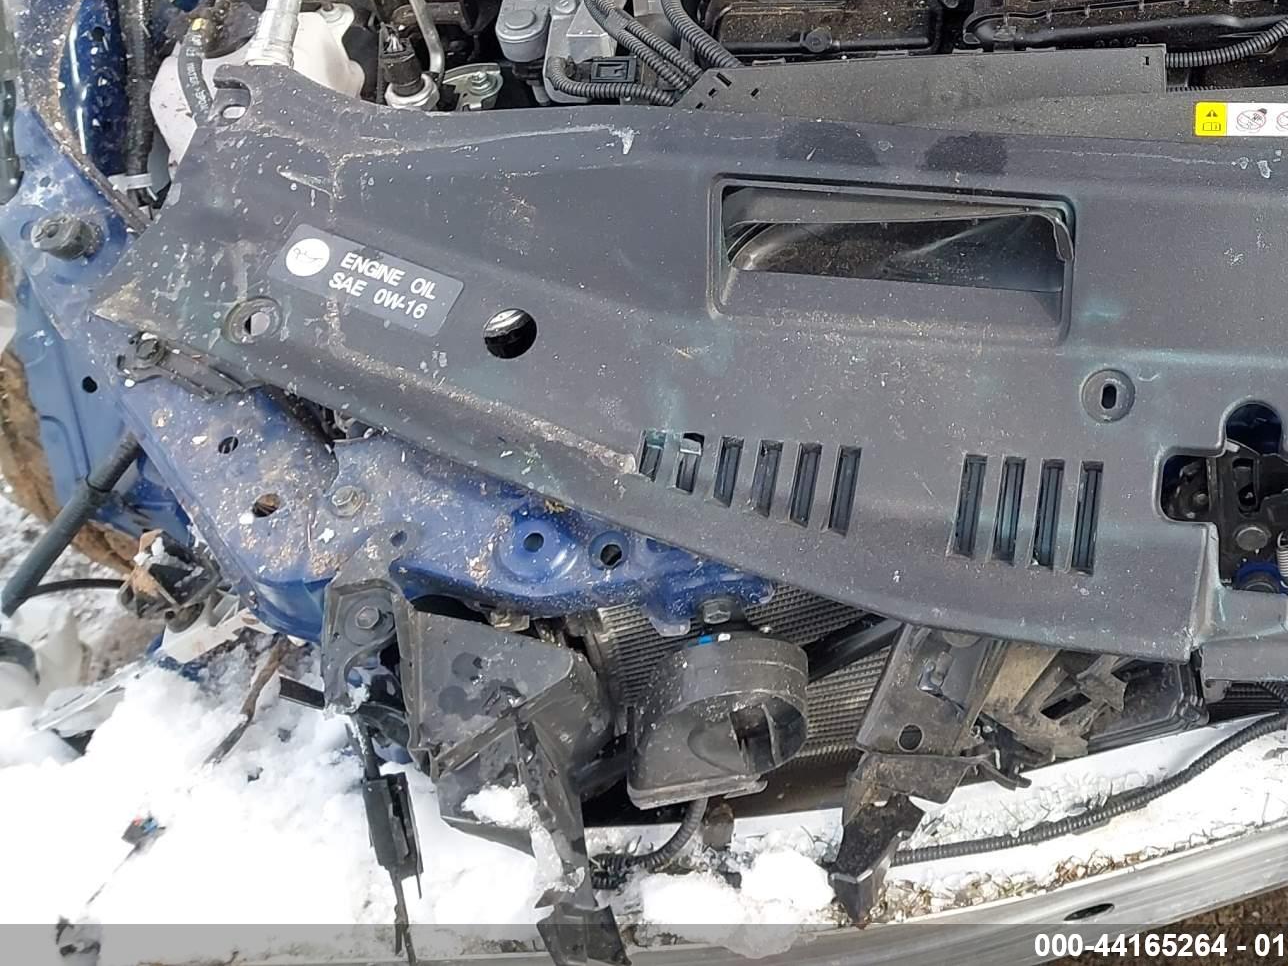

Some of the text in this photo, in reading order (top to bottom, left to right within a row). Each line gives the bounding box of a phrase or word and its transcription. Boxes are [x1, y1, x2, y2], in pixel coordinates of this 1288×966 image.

[329, 272, 428, 319] SAE 0W-16
[341, 252, 437, 300] ENGINE OIL
